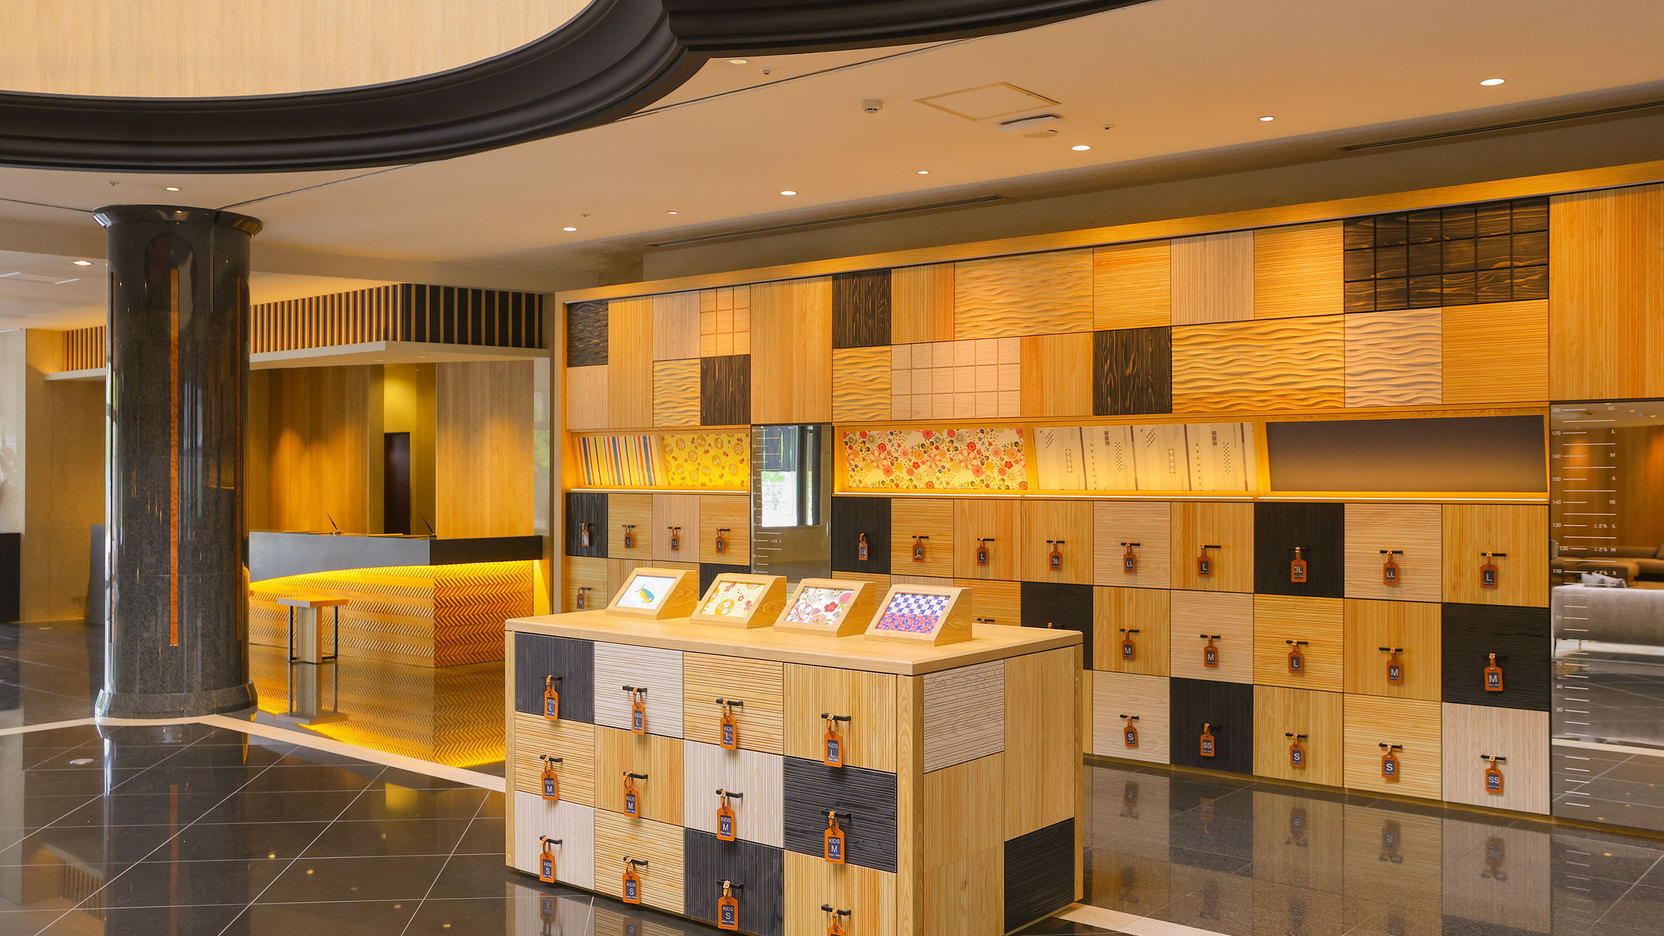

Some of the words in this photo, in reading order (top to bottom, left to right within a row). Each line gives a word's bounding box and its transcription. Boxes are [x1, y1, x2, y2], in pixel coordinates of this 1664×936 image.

[1293, 659, 1299, 667] L
[1391, 668, 1399, 676] M
[1489, 675, 1497, 683] M
[1294, 752, 1300, 761] S
[1387, 763, 1393, 771] S
[1489, 776, 1499, 784] SS
[723, 823, 729, 831] M
[726, 912, 731, 920] S
